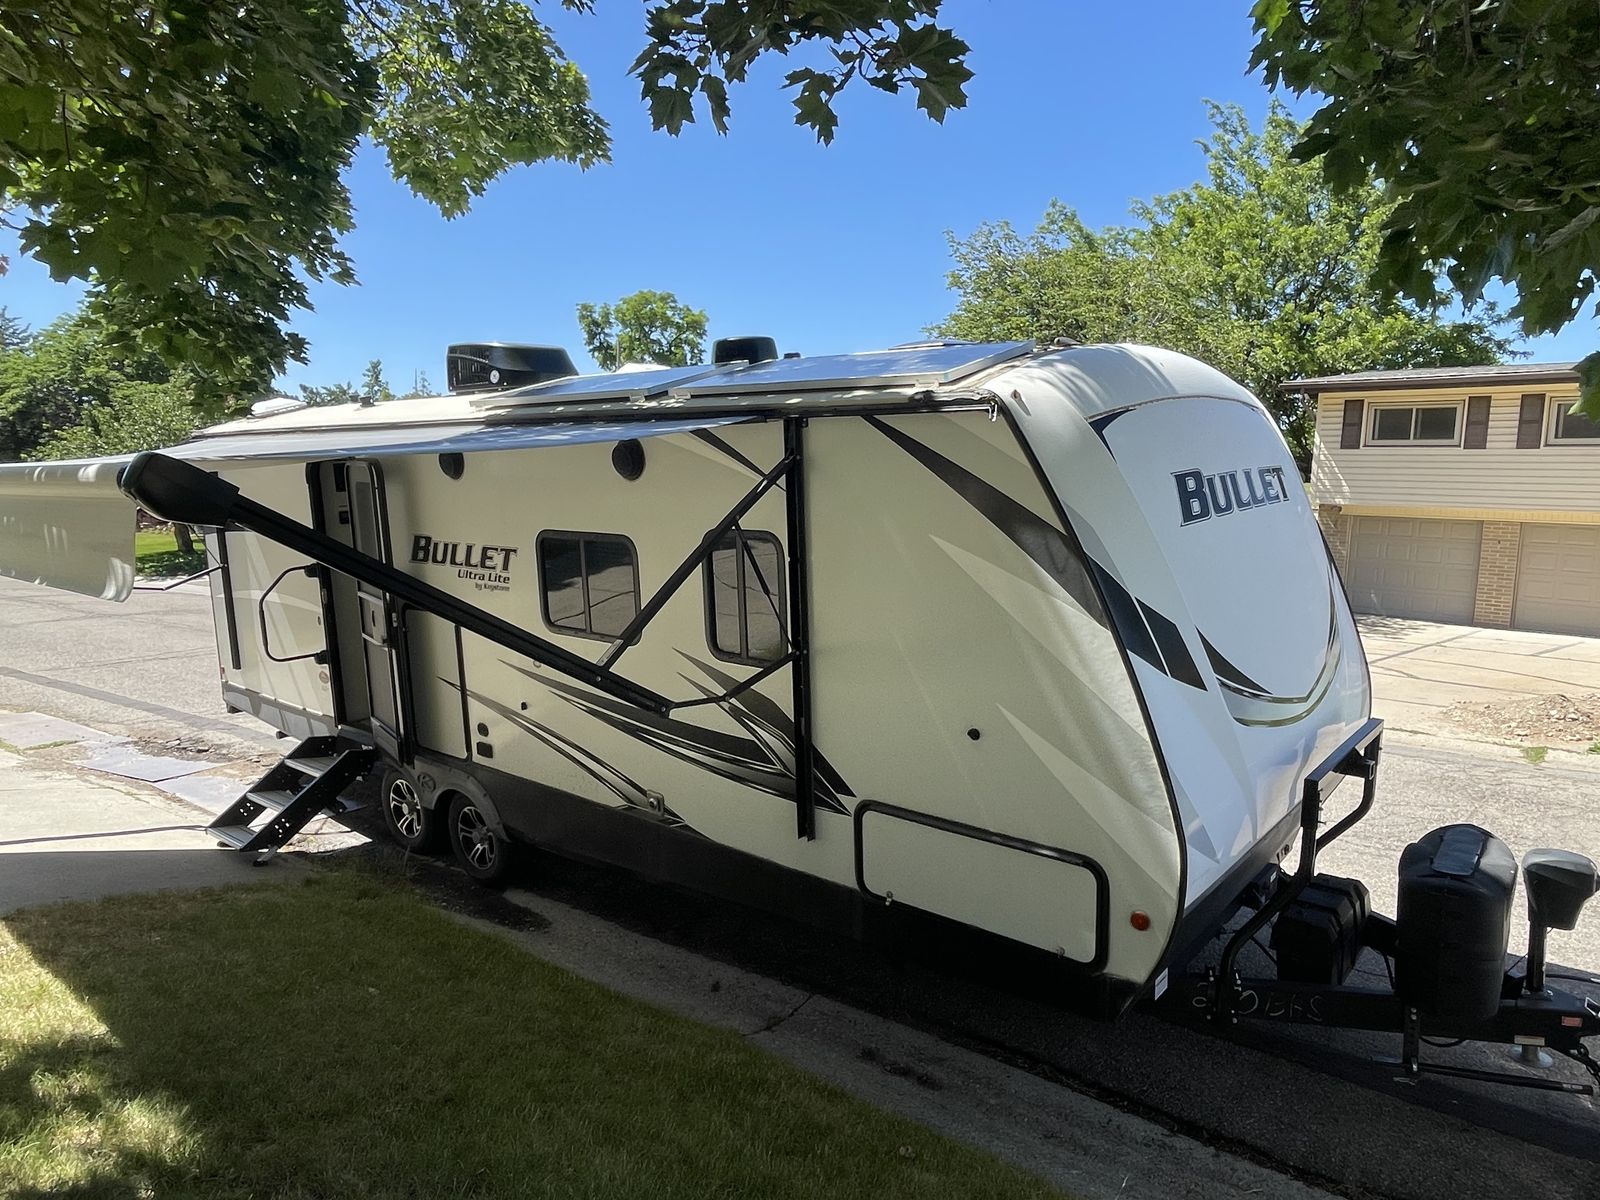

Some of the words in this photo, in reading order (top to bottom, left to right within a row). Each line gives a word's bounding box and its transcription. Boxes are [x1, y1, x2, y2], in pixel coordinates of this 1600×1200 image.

[1170, 465, 1290, 527] BULLET
[409, 533, 518, 573] BULLET
[457, 569, 485, 581] Ultra
[488, 572, 511, 584] Lite
